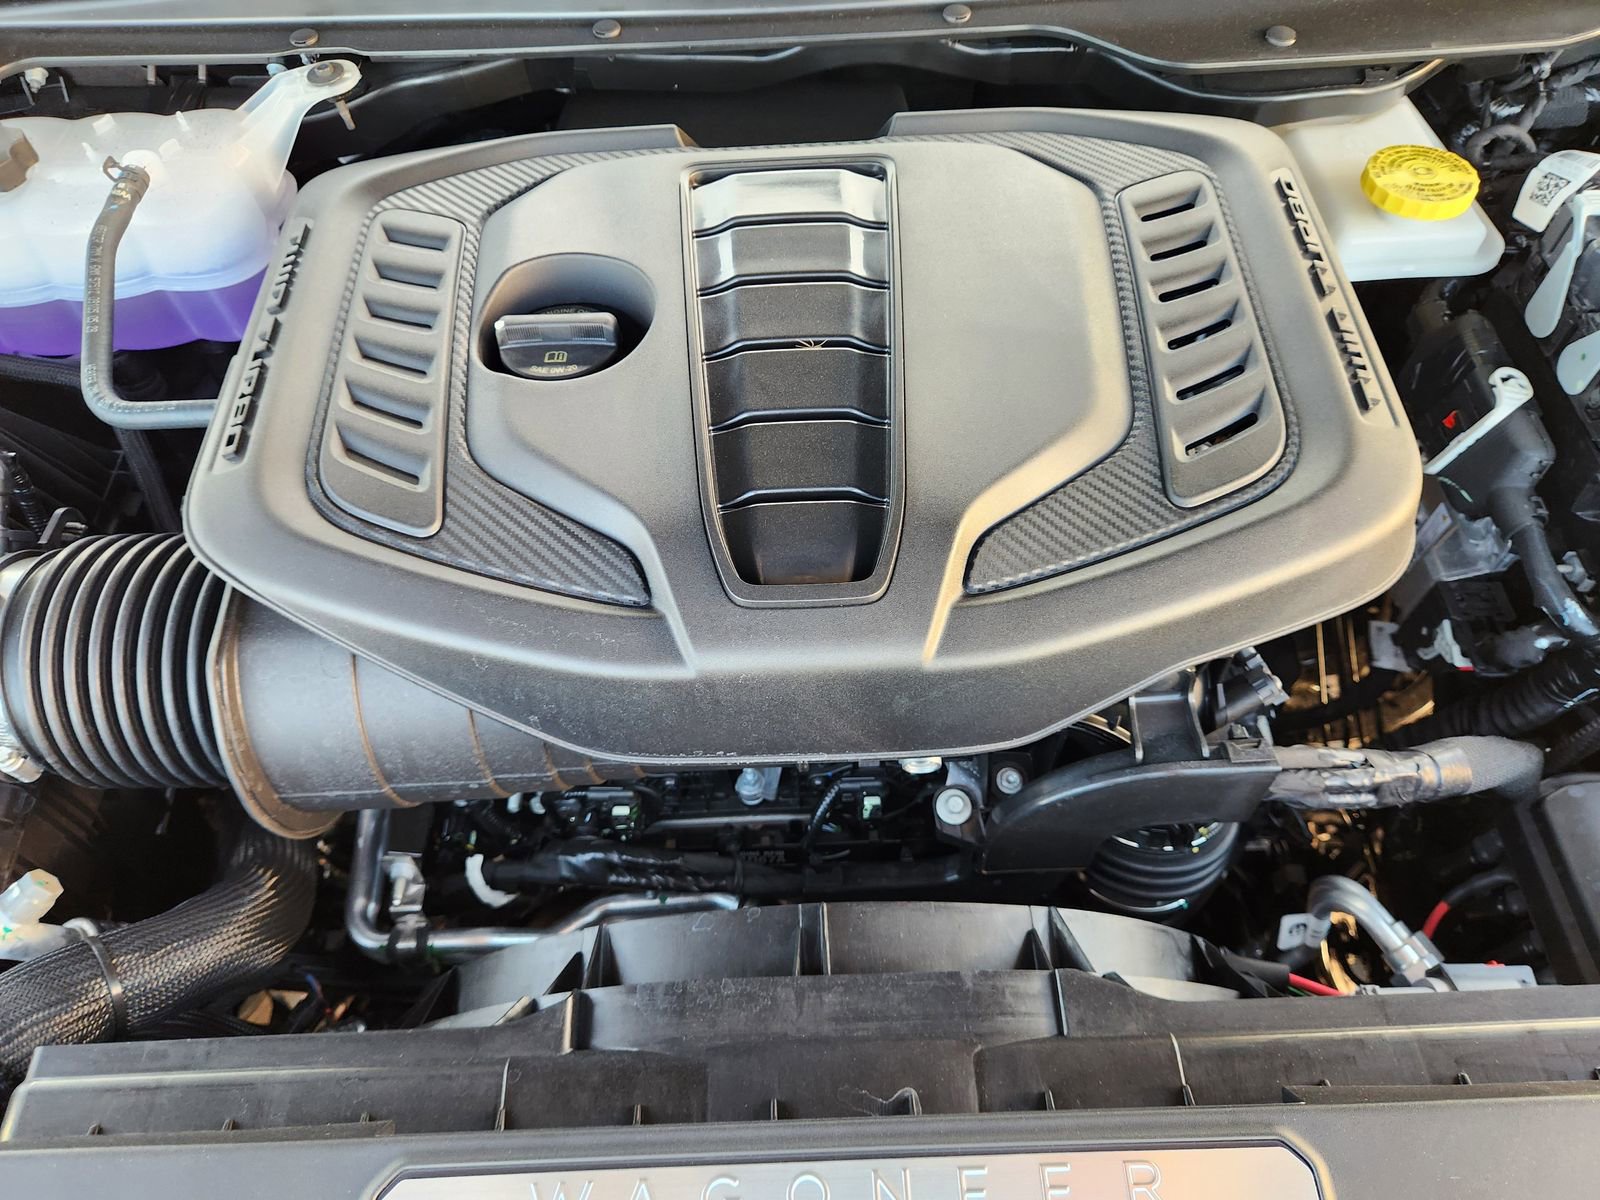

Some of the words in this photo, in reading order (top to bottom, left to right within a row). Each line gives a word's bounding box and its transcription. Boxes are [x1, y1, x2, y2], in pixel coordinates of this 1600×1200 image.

[1276, 176, 1337, 298] TURBO
[221, 316, 282, 463] TURBO
[529, 365, 549, 374] SAE
